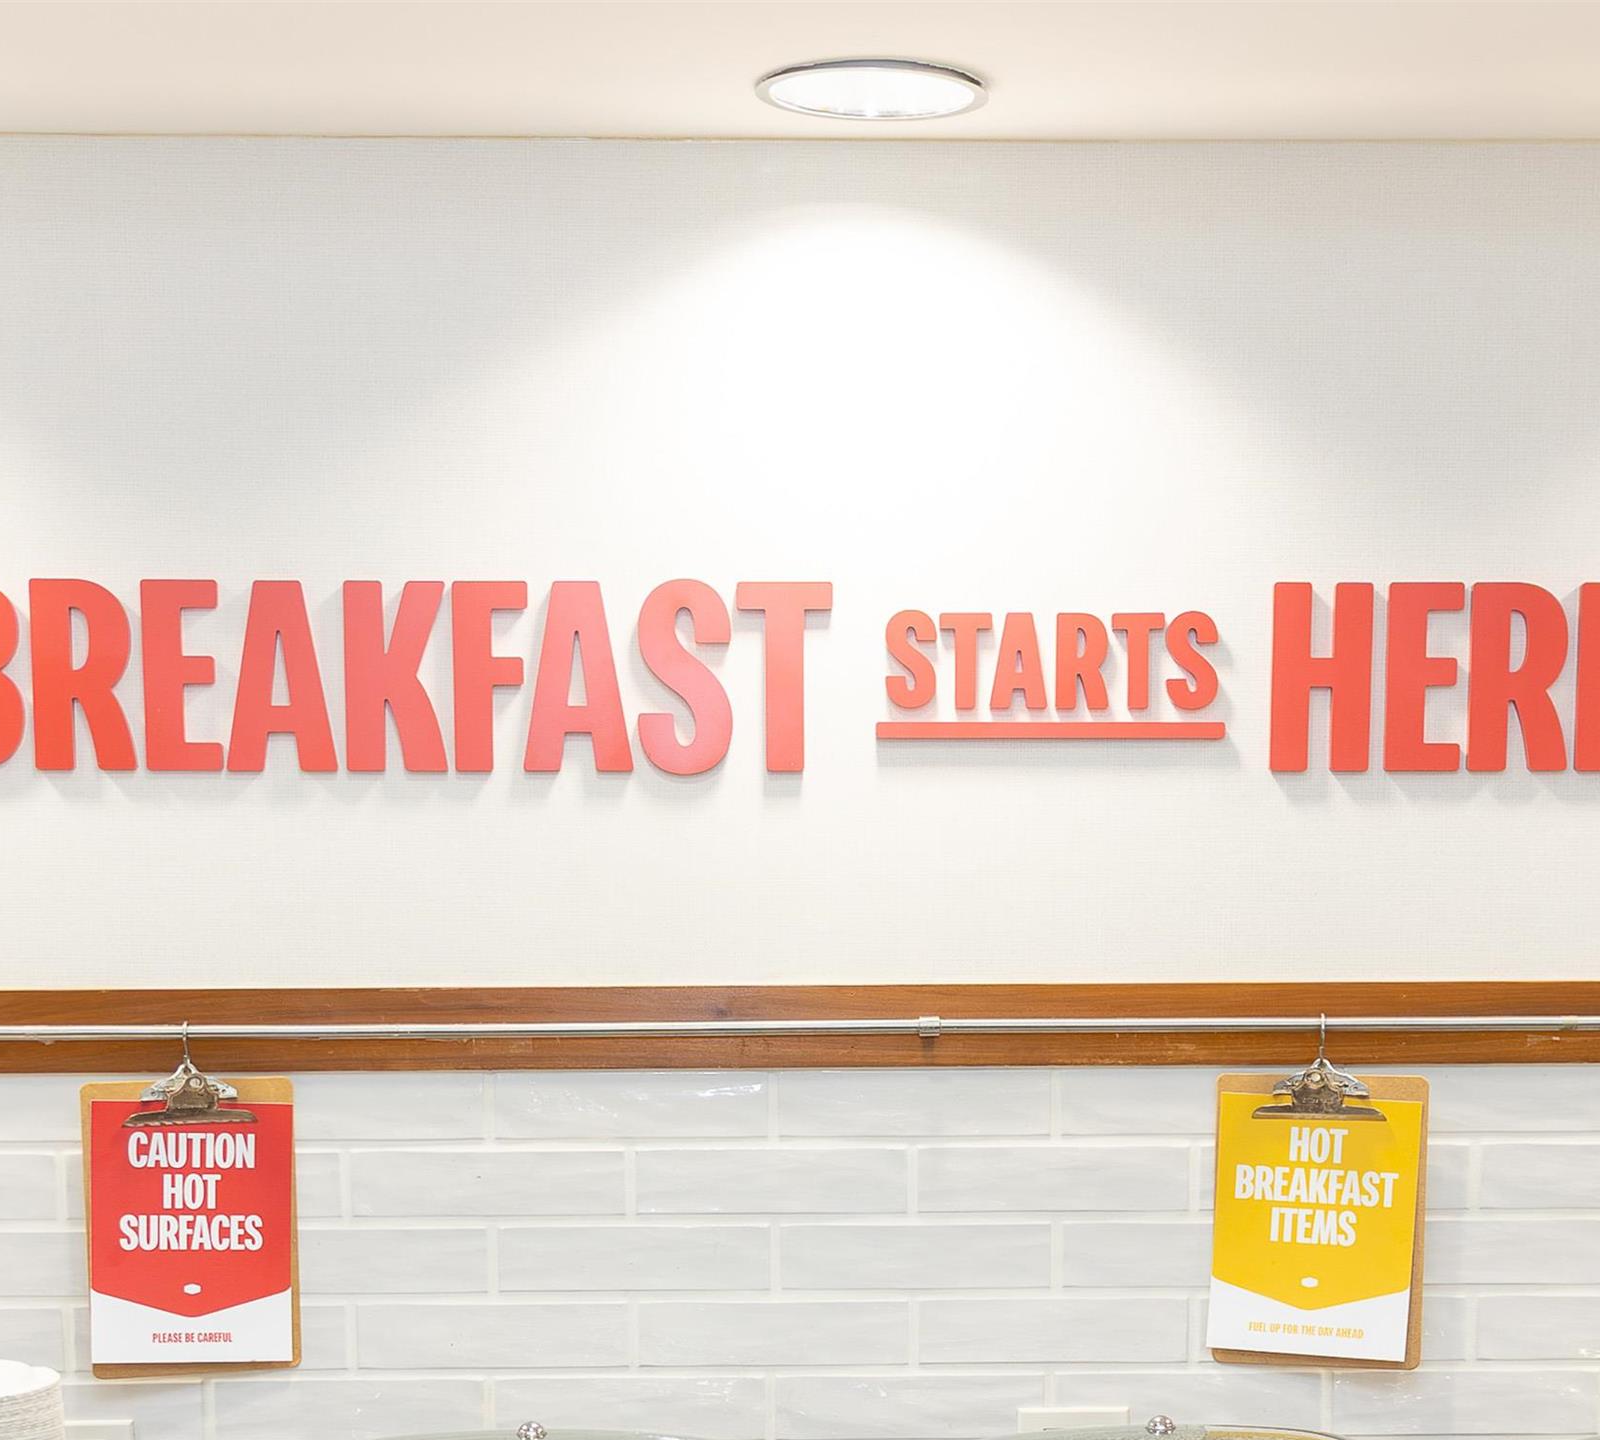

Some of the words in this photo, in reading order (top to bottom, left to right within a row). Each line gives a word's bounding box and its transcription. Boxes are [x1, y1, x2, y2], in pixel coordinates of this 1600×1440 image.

[883, 608, 1221, 713] STARTS
[127, 1131, 256, 1169] CAUTION
[1288, 1126, 1349, 1164] HOT
[162, 1173, 222, 1209] HOT
[1234, 1164, 1400, 1208] BREAKFAST
[118, 1213, 264, 1251] SURFACES
[1269, 1207, 1358, 1247] ITEMS
[152, 1332, 182, 1343] PLEASE
[185, 1332, 195, 1343] BE
[197, 1332, 233, 1343] CAREFUL
[1248, 1321, 1266, 1333] FUEL
[1269, 1323, 1281, 1333] UP
[1282, 1323, 1298, 1335] FOR
[1301, 1324, 1316, 1336] THE
[1318, 1326, 1334, 1337] DAY
[1336, 1327, 1364, 1339] AHEAD
